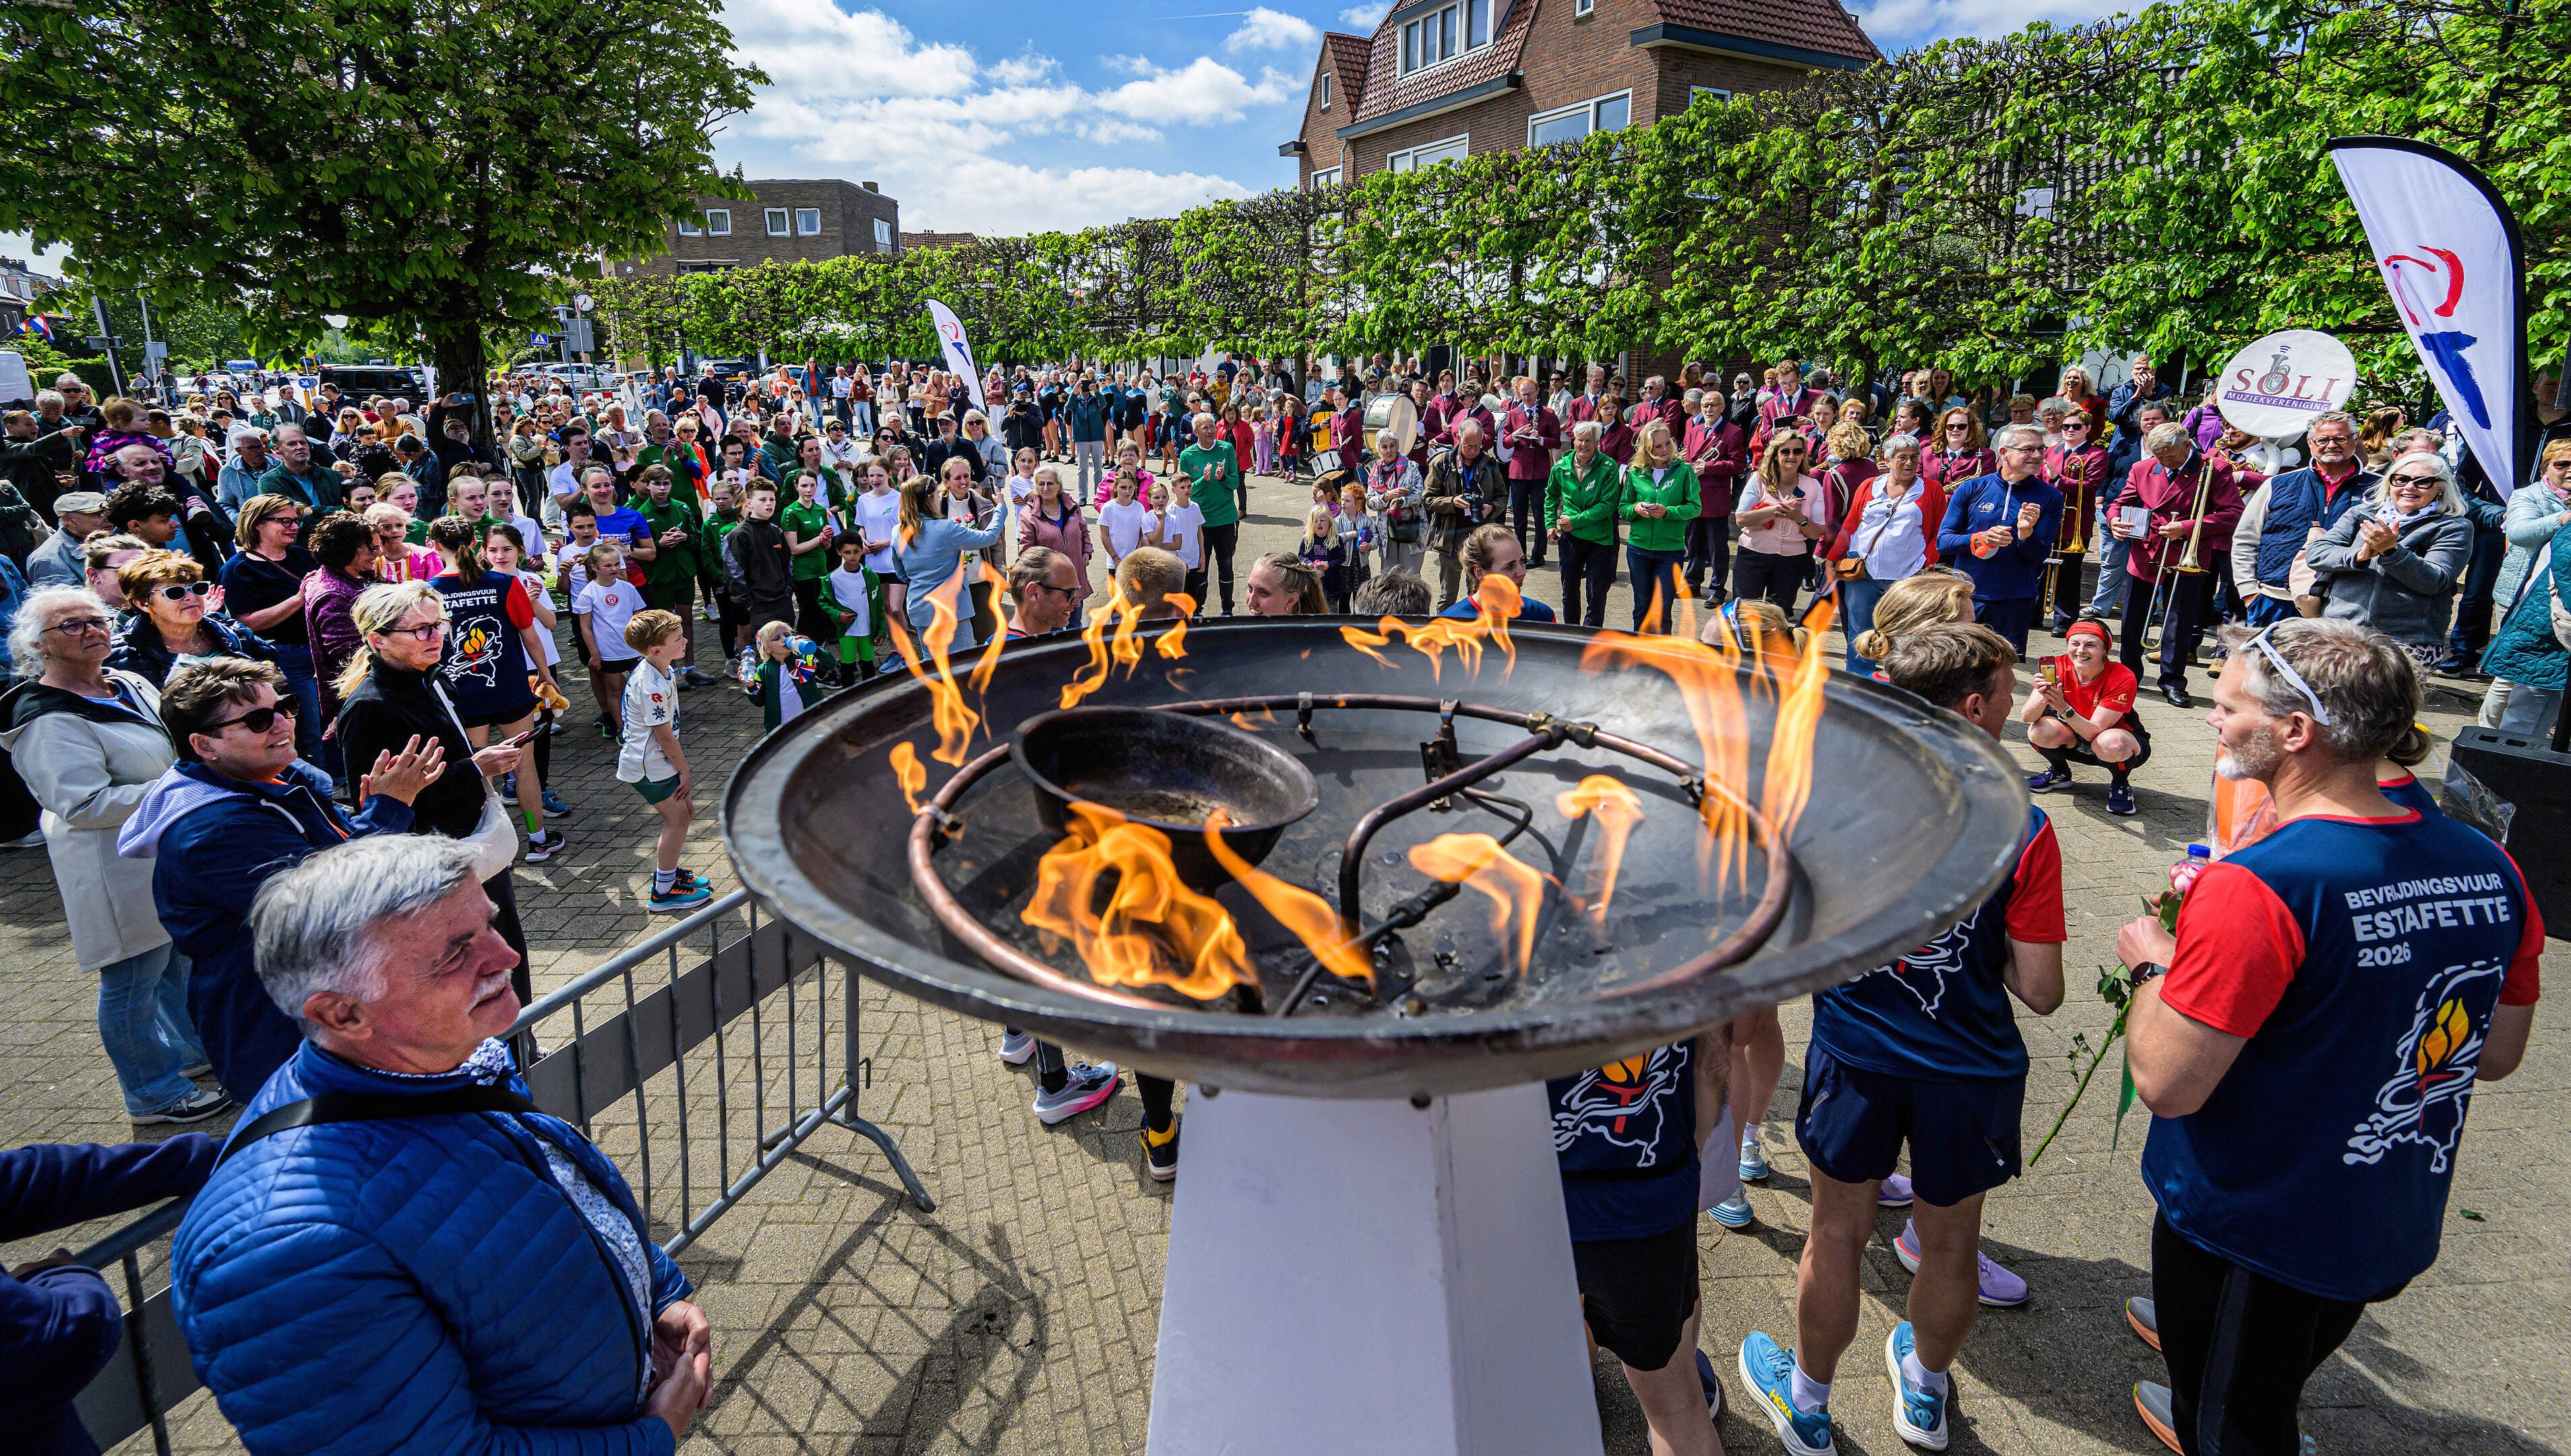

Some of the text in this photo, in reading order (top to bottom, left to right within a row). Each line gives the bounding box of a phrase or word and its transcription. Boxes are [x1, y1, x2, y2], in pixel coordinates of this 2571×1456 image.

[2231, 368, 2340, 402] SOLI
[2227, 392, 2329, 411] MUZIEKVERENIGING
[442, 588, 497, 600] RIJDINGSVUUR
[444, 595, 497, 609] TAFETTE
[2345, 873, 2504, 909] BEVRIJDINGSVUUR
[2351, 895, 2510, 942] ESTAFETTE
[2357, 942, 2411, 967] 2026
[1769, 1389, 1792, 1422] HOKA
